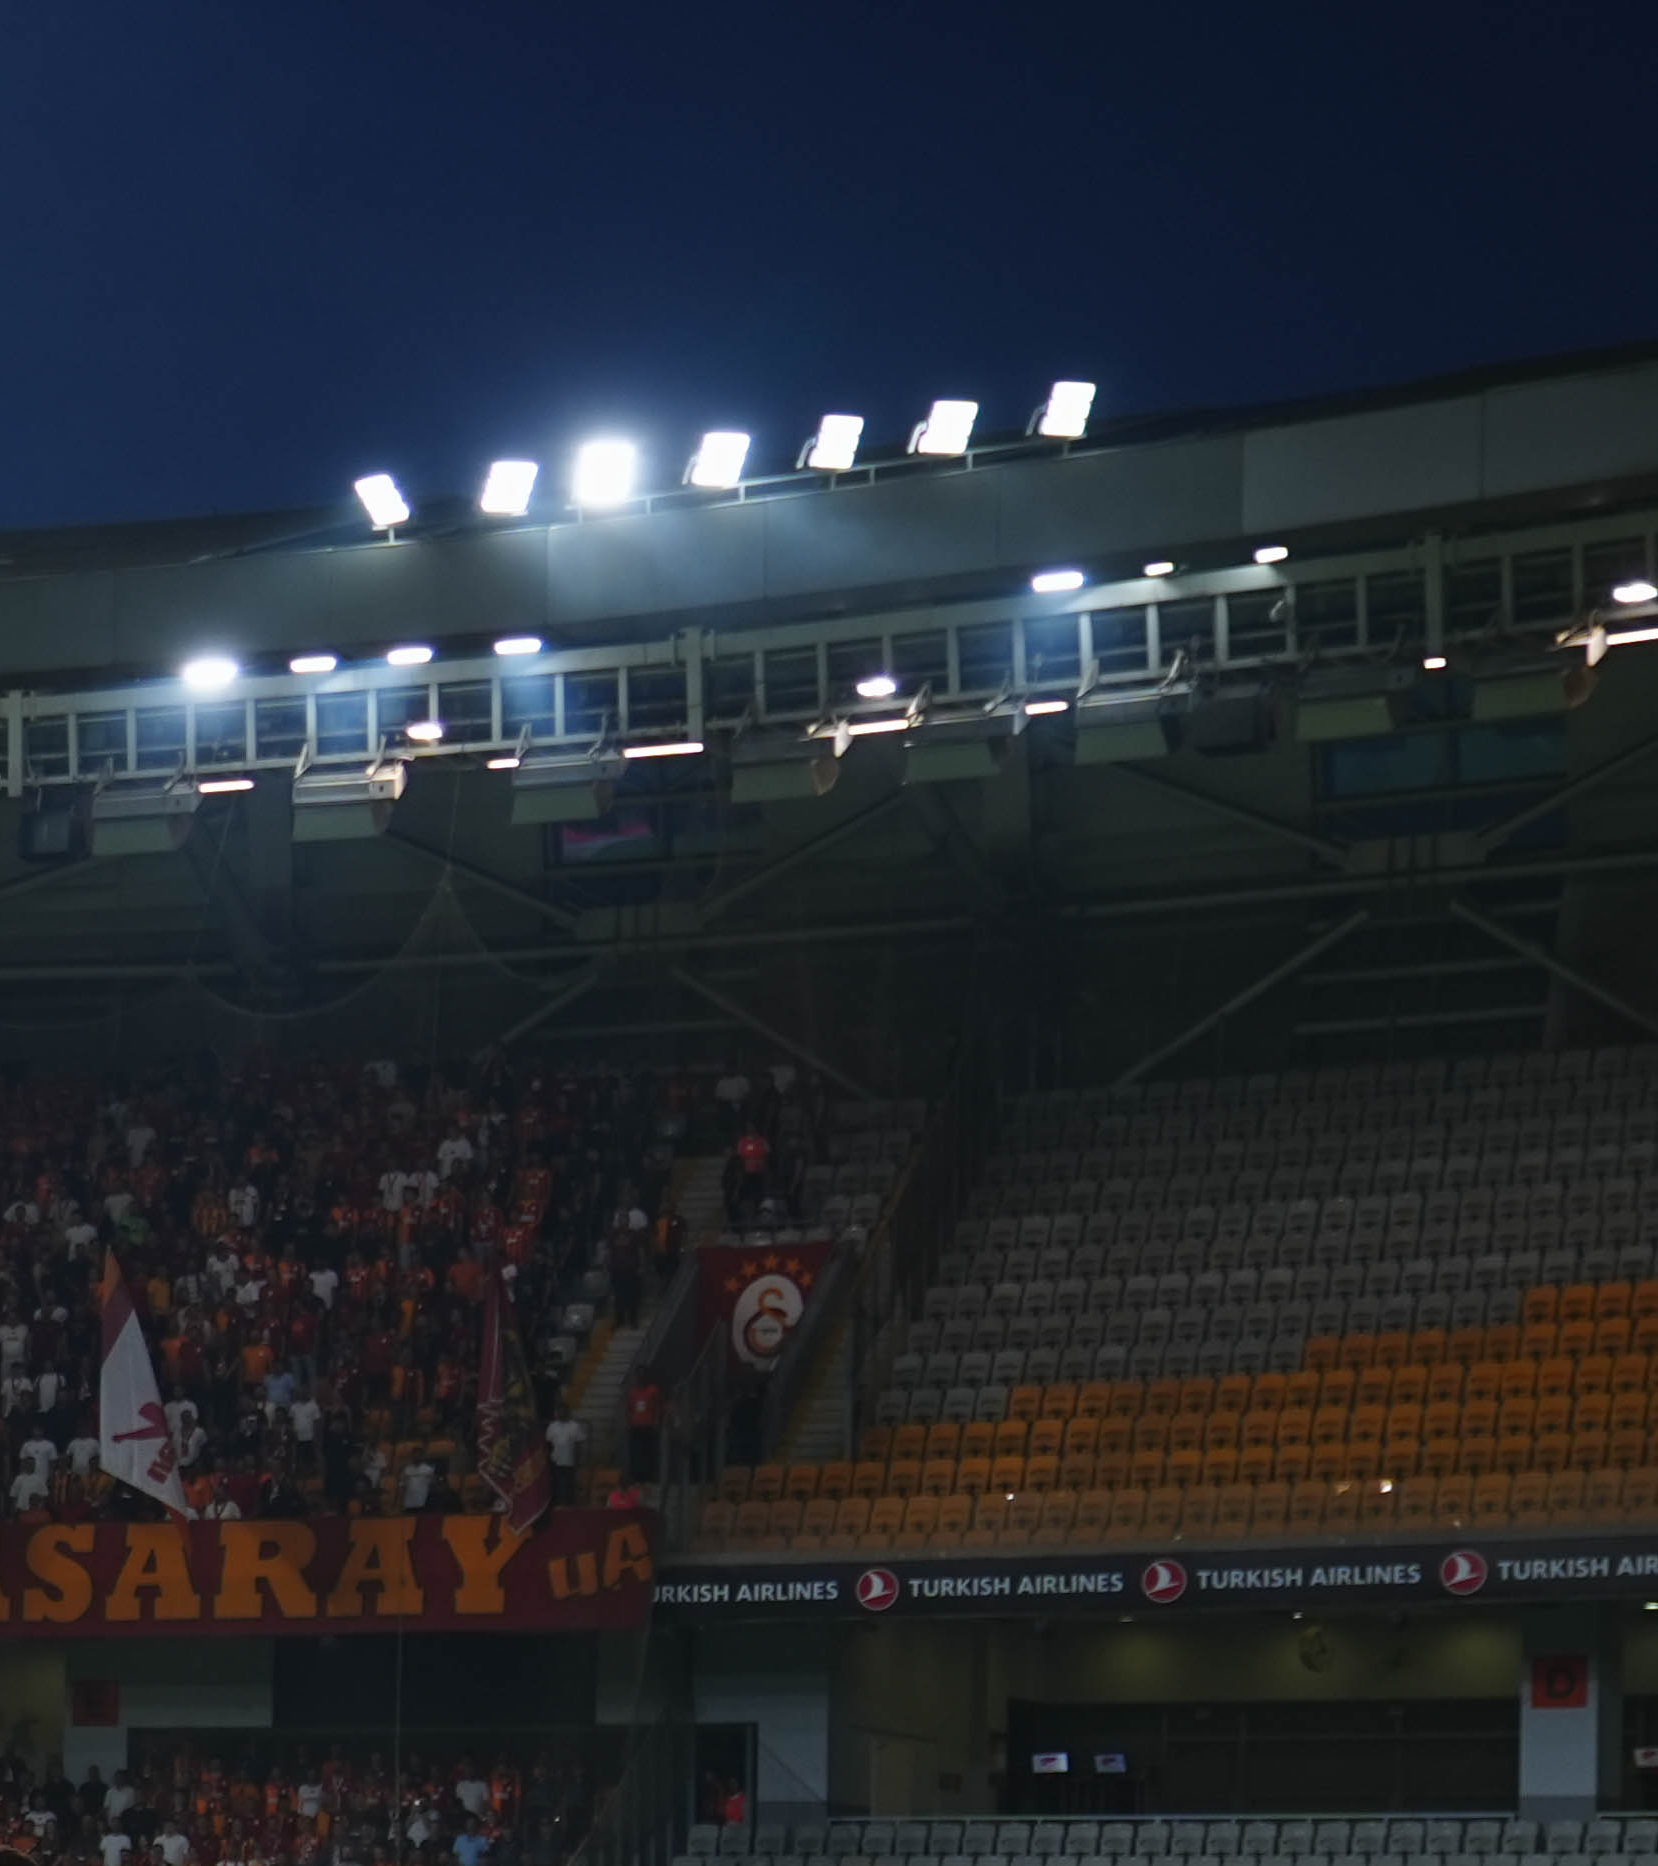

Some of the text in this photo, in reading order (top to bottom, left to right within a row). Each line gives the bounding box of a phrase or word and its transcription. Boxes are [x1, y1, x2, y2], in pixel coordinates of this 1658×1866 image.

[1198, 1566, 1420, 1588] TURKISH AIRLINES
[1499, 1559, 1608, 1579] TURKISH
[654, 1582, 838, 1603] RKISH AIRLINES
[910, 1575, 1122, 1596] TURKISH AIRLINES
